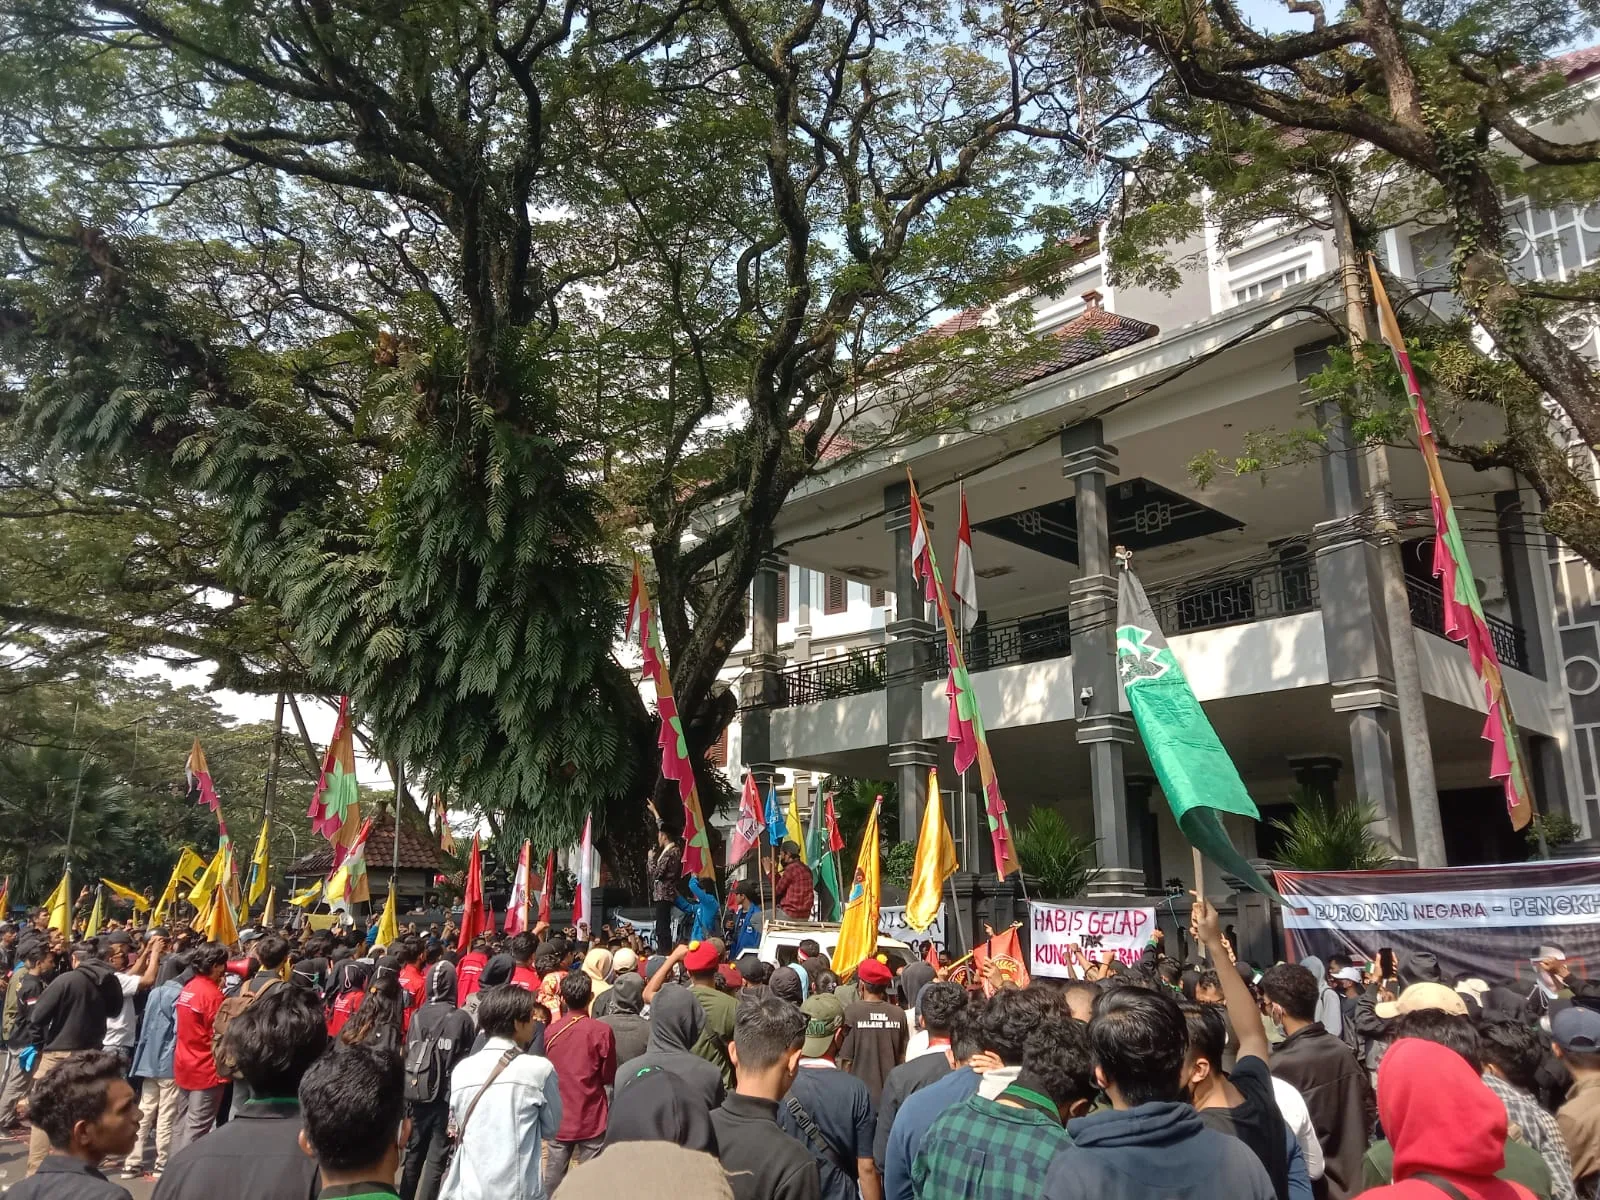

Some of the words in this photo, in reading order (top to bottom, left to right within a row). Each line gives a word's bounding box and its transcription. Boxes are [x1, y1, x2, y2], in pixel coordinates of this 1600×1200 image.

[1315, 902, 1409, 921] BURONAN
[1413, 902, 1488, 920] NEGARA
[1088, 909, 1148, 938] GELAP
[1079, 934, 1104, 949] TAK
